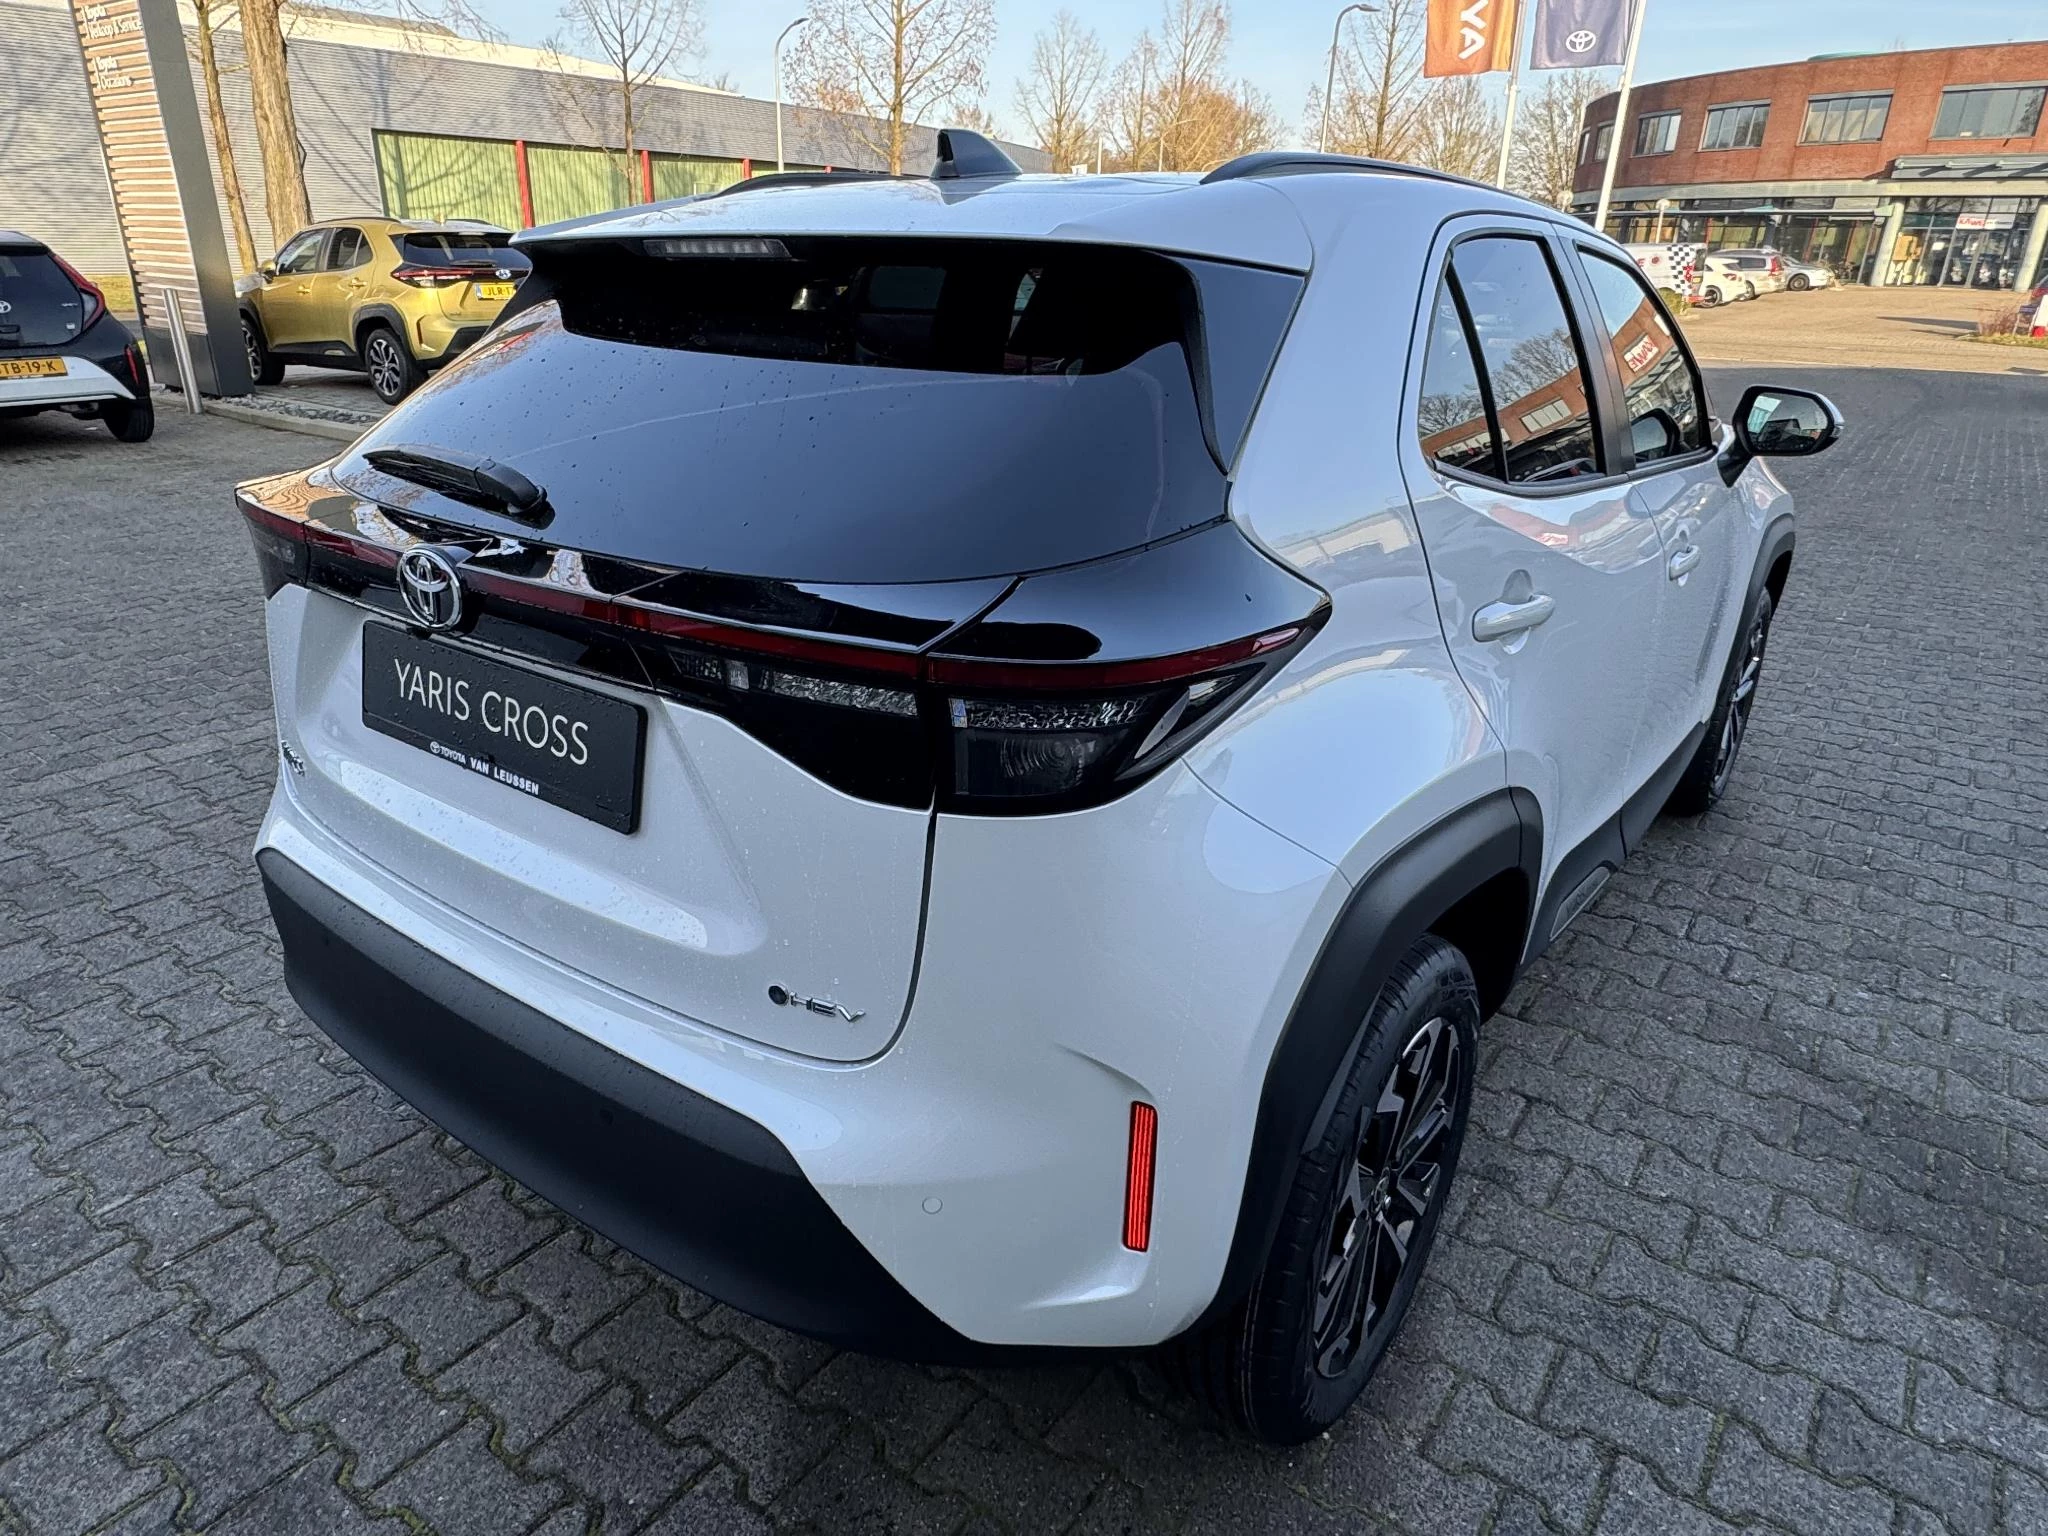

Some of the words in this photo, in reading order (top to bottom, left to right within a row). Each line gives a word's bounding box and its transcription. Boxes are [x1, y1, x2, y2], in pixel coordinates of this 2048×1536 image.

[0, 360, 56, 376] TB-19-K
[394, 658, 470, 721] YARIS
[481, 691, 588, 766] CROSS
[440, 745, 466, 764] TOYOTA
[470, 757, 489, 775] VAN
[493, 766, 539, 795] LEUSSEN
[790, 991, 866, 1022] HEV
